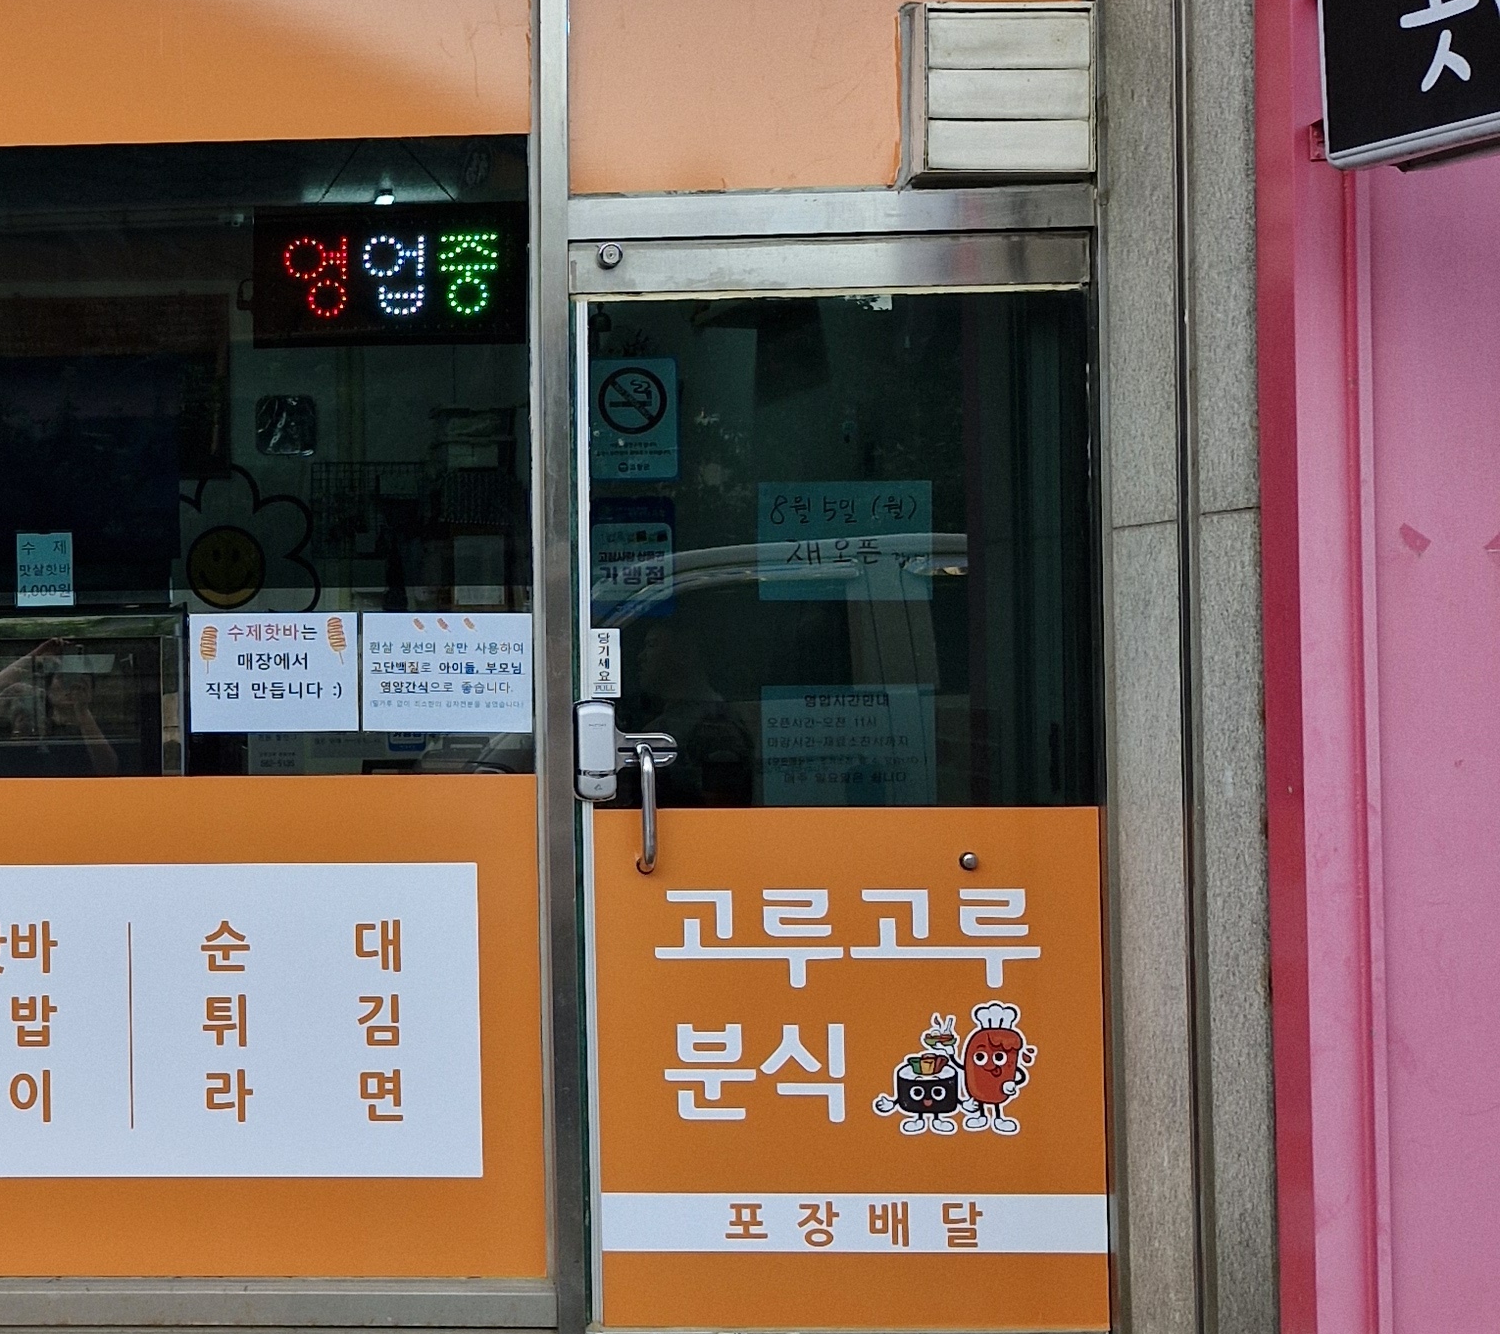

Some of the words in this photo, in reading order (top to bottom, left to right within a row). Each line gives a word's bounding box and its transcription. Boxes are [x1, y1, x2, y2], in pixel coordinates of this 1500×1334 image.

[283, 232, 499, 319] 영업중
[770, 494, 811, 525] 8월
[823, 495, 858, 524] 5일
[871, 494, 917, 521] (월)
[19, 583, 71, 598] 4,000원
[227, 623, 318, 642] 수제핫바는
[475, 641, 524, 655] 사용하여
[597, 632, 611, 682] 당기세요
[237, 652, 308, 671] 매장에서
[486, 661, 524, 674] 부모님
[205, 681, 240, 700] 직접
[251, 681, 324, 700] 만듭니다
[654, 888, 1042, 989] 고루고루
[664, 1023, 847, 1124] 분식
